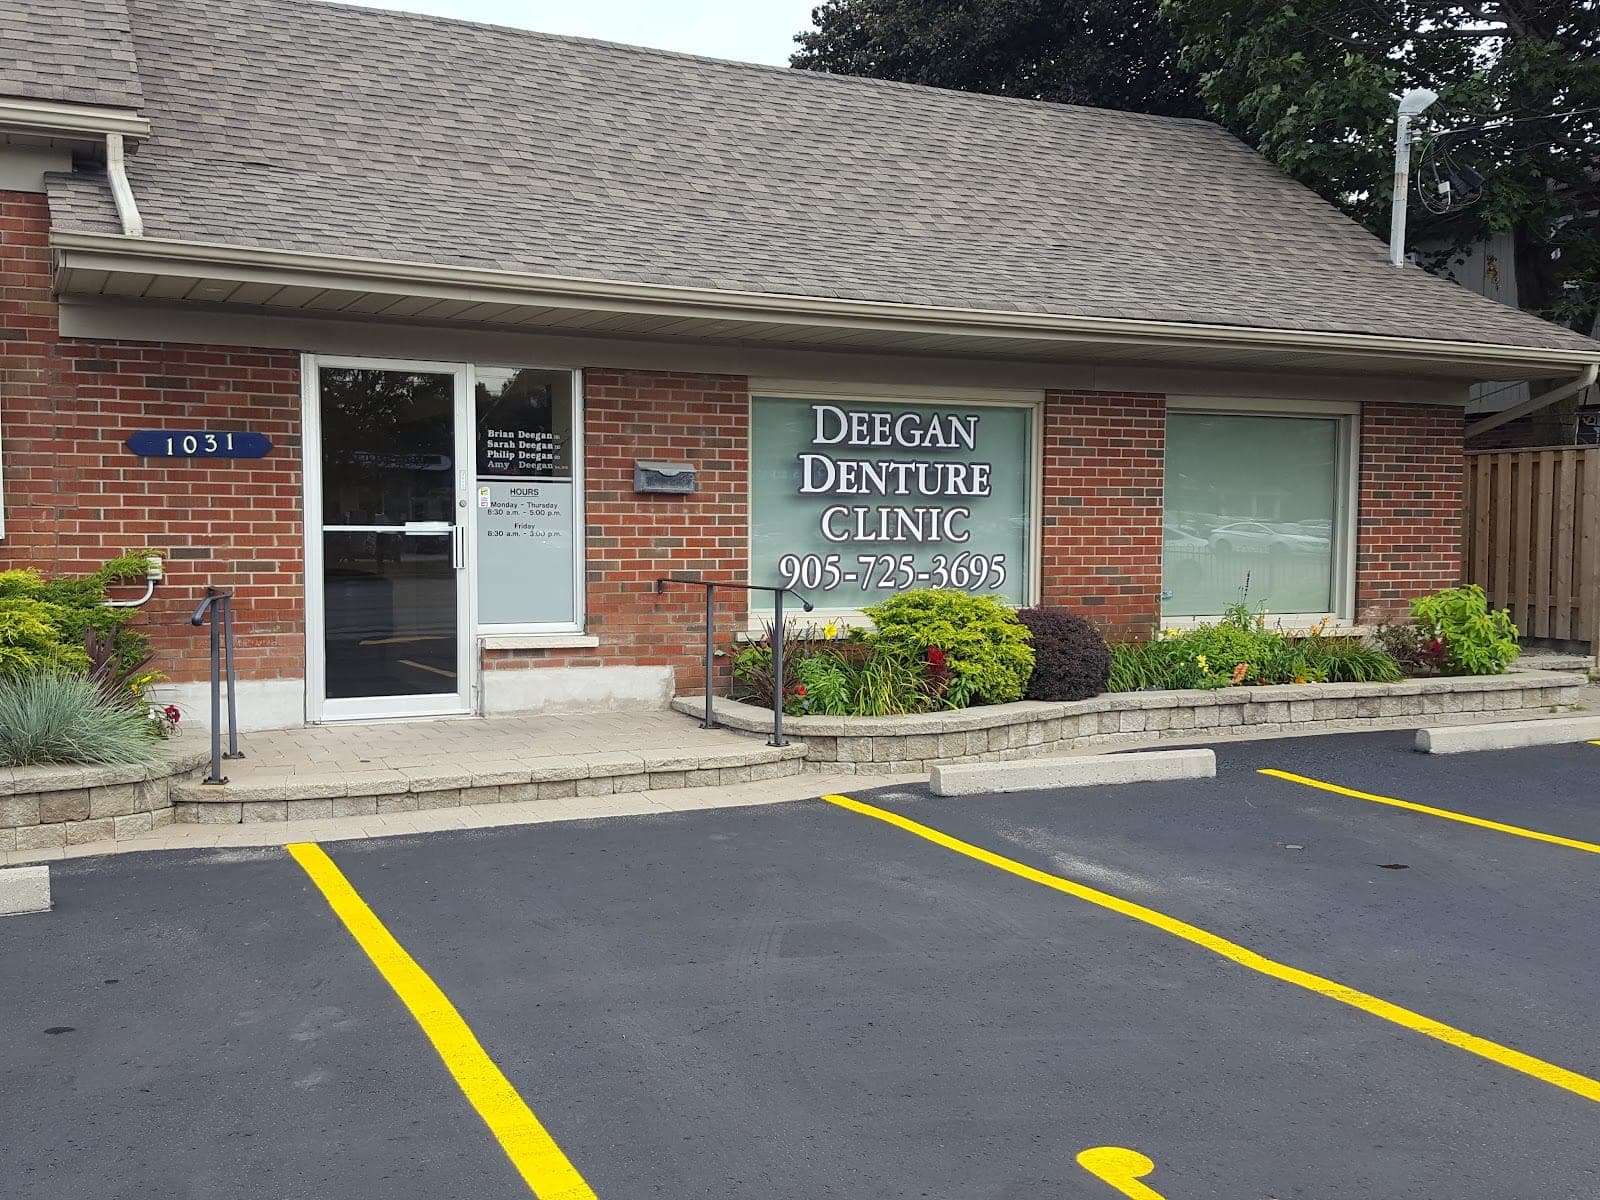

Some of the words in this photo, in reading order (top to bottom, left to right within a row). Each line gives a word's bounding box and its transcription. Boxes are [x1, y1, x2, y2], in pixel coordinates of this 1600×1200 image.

[811, 404, 980, 450] DEEGAN
[488, 430, 514, 439] Brian
[518, 430, 552, 440] Deegan
[166, 433, 234, 456] 1031
[487, 440, 515, 449] Sarah
[519, 441, 553, 451] Deegan
[487, 450, 515, 460] Philip
[519, 451, 553, 461] Deegan
[488, 461, 510, 470] Amy
[519, 461, 553, 470] Deegan
[798, 453, 991, 496] DENTURE
[510, 488, 539, 496] HOURS
[491, 502, 518, 510] Monday
[526, 502, 558, 510] Thursday
[514, 522, 535, 531] Friday
[821, 505, 971, 542] CLINIC
[778, 551, 1007, 590] 905-725-3695
